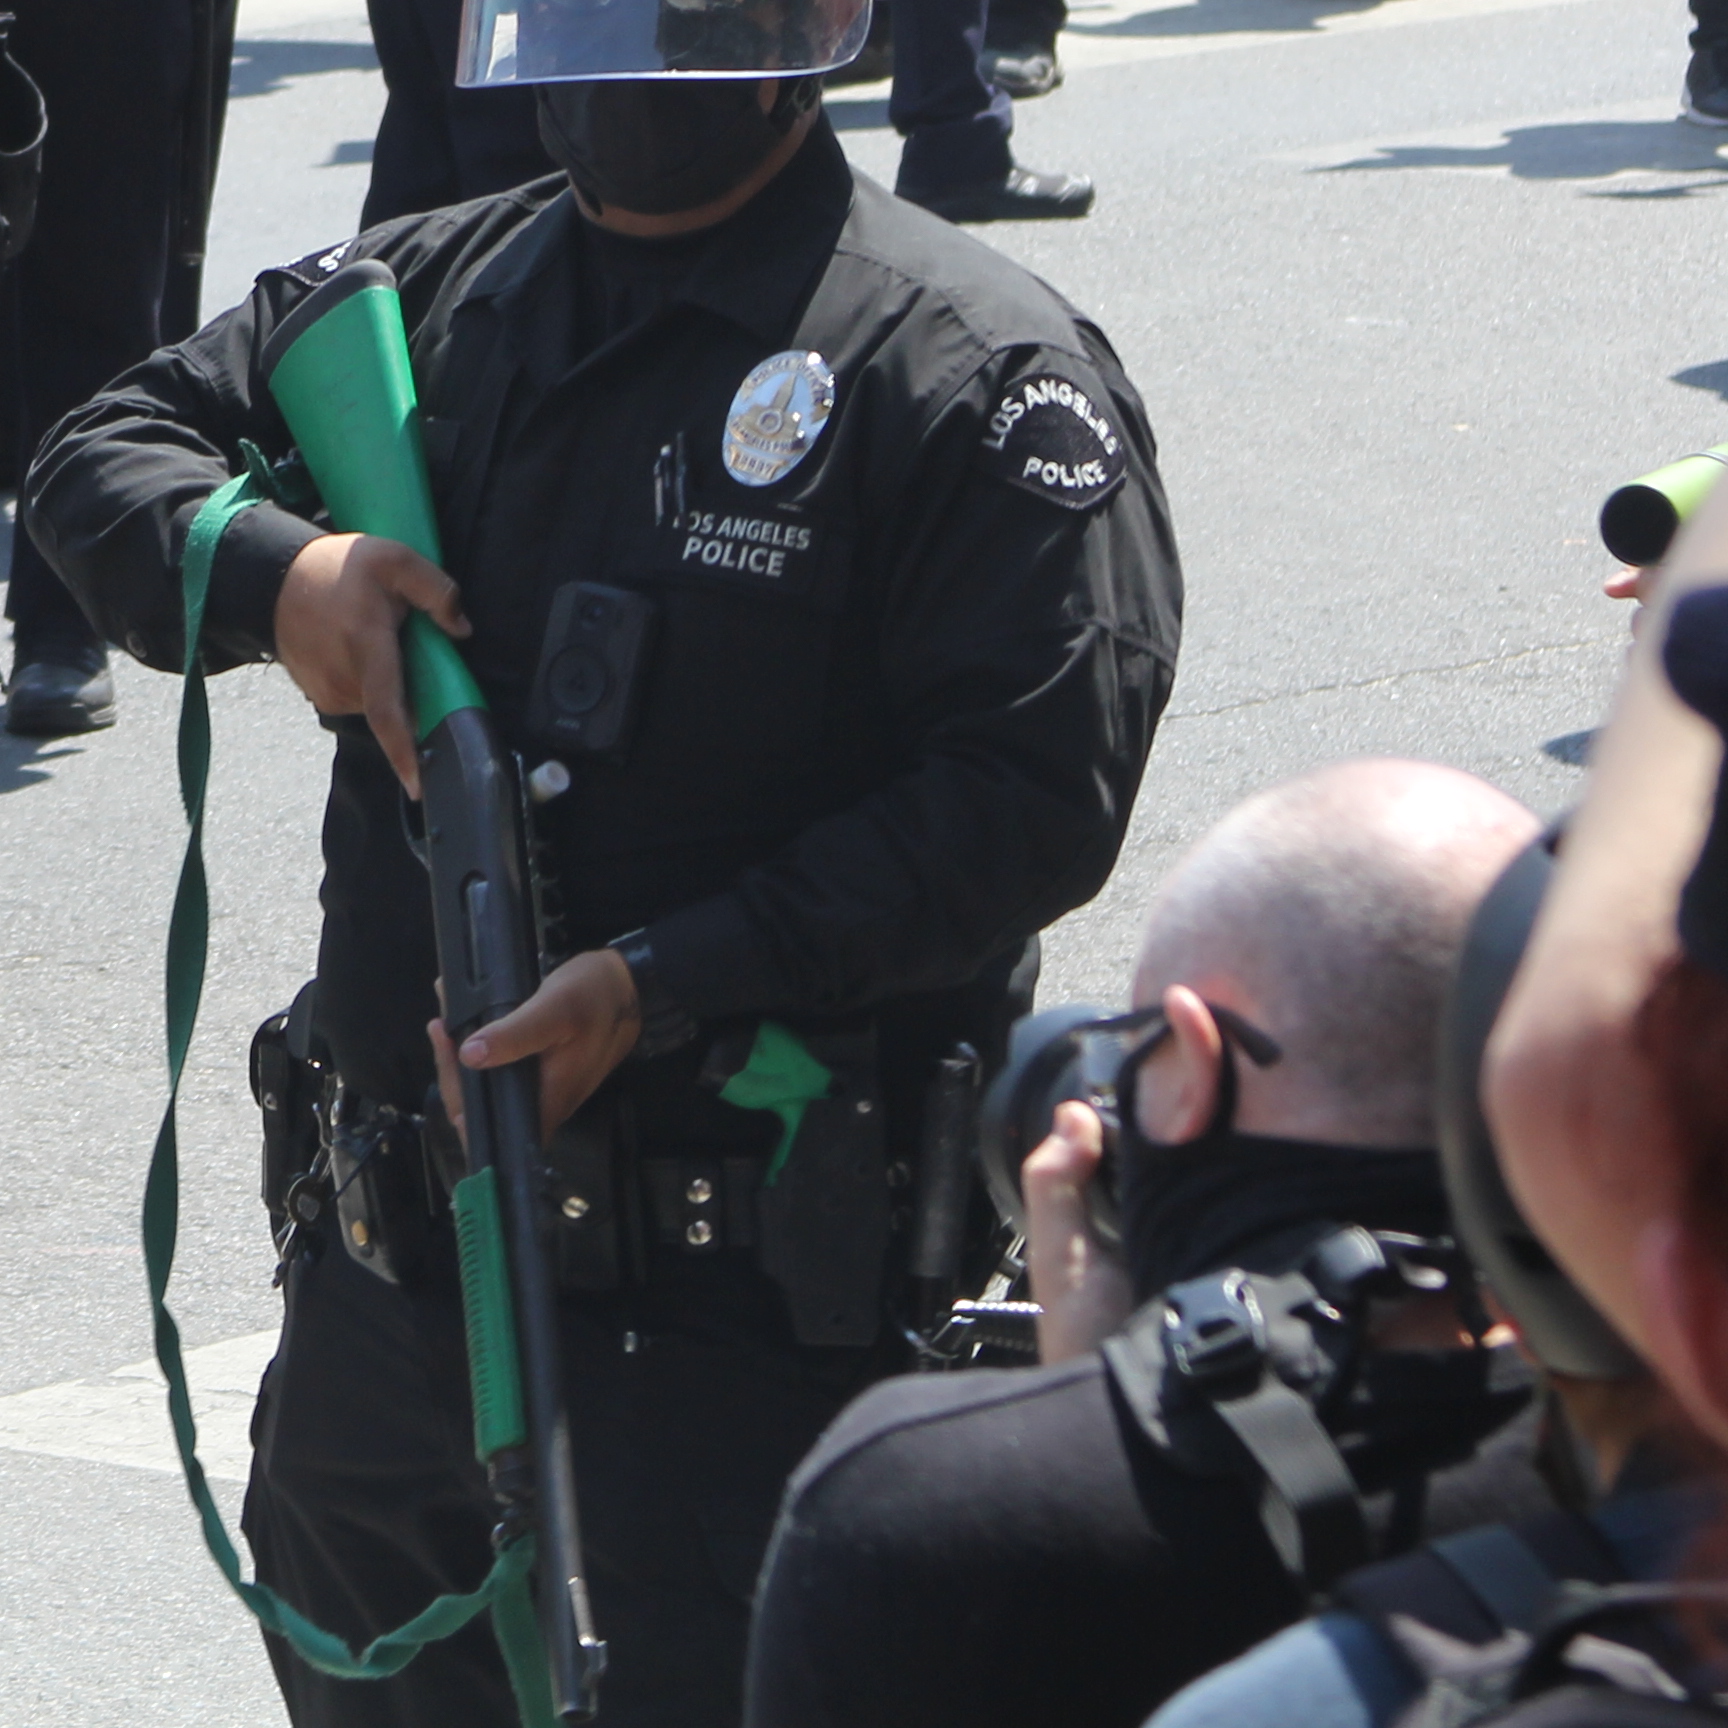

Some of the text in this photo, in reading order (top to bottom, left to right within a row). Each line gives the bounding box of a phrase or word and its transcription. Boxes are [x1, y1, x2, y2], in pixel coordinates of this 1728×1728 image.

[981, 395, 1026, 452] LOS
[1021, 455, 1108, 490] POLICE
[687, 510, 812, 552] OS ANGELES
[681, 535, 787, 579] POLICE
